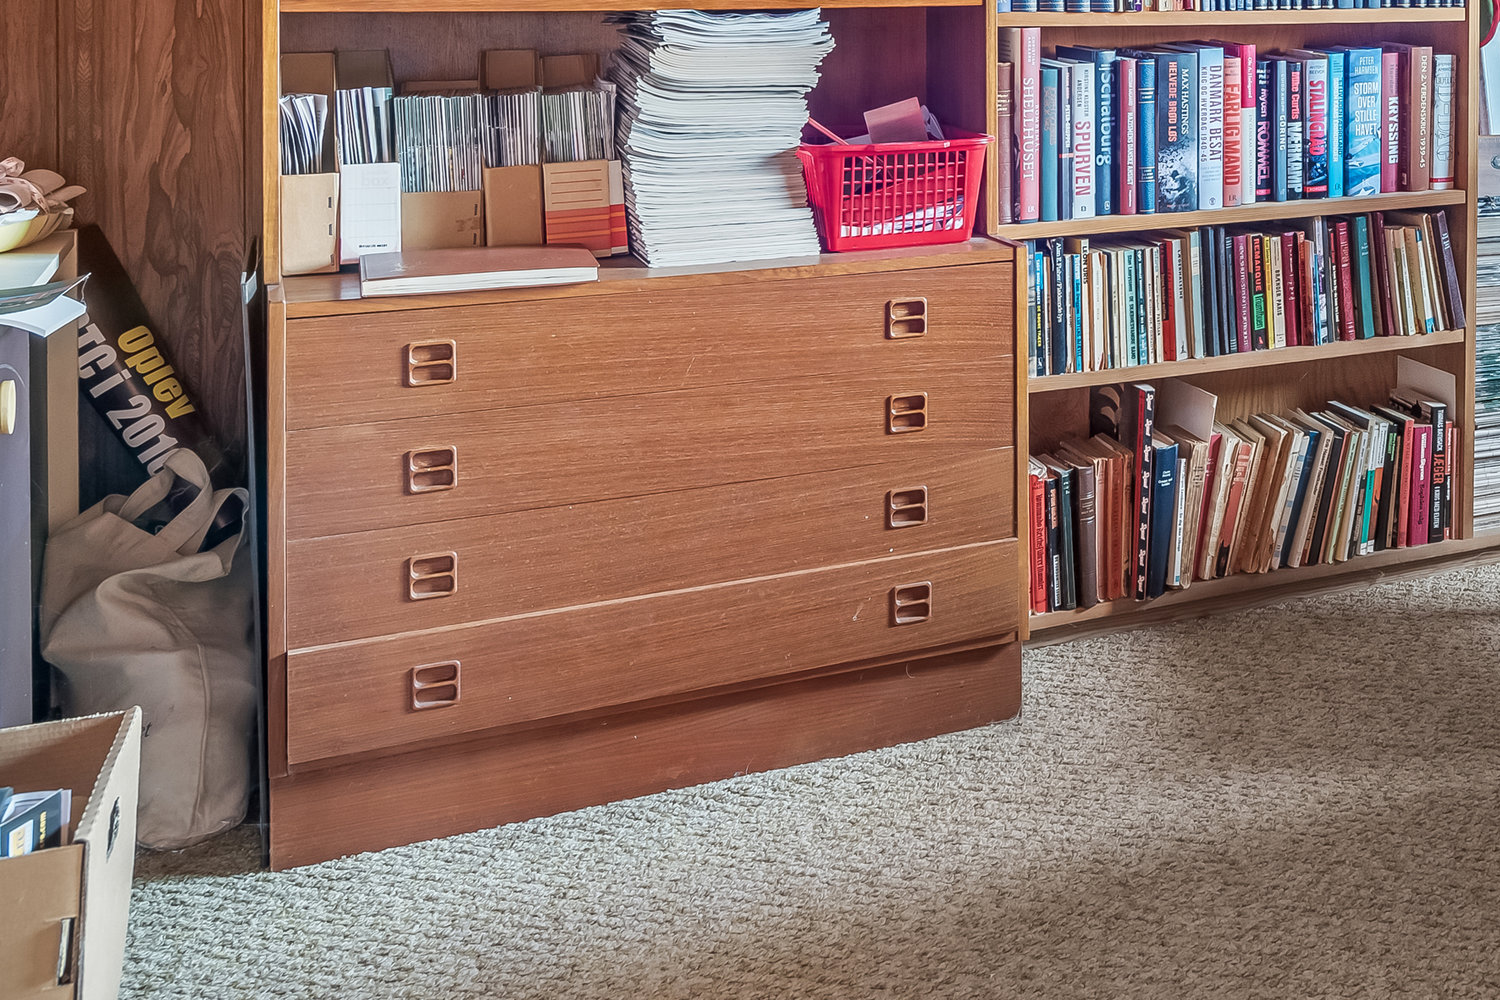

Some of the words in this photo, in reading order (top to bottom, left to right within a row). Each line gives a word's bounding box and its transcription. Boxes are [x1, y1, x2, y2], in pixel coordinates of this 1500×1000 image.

[1355, 66, 1378, 74] HARMSEN
[1360, 56, 1374, 65] PETER
[1168, 62, 1177, 98] HELVEDE
[1201, 85, 1207, 95] OG
[1209, 65, 1222, 123] DANMARK
[1354, 82, 1378, 95] STORM
[1096, 72, 1115, 166] Schalburg
[1168, 101, 1177, 124] BRØD
[1181, 91, 1189, 135] HASTINGS
[1224, 83, 1239, 137] FARLIG
[1259, 88, 1268, 117] Myten
[1292, 94, 1300, 120] Curtis
[1308, 80, 1325, 156] STALINGRAD
[1355, 109, 1378, 122] STILLE-
[1358, 95, 1376, 108] OVER
[1023, 77, 1034, 181] SHELLHUSET
[1168, 126, 1177, 142] LØS
[1209, 128, 1221, 162] BESAT
[1355, 123, 1377, 136] HAVET
[1388, 96, 1399, 164] KRYSSING
[1075, 121, 1091, 196] SPURVEN
[1224, 140, 1240, 186] MAND
[1257, 121, 1270, 185] ROMMEL
[1287, 122, 1303, 193] NÆRKAMP
[1254, 239, 1262, 291] REMARQUE
[89, 369, 132, 398] i
[118, 325, 195, 419] Oplev
[1433, 454, 1444, 484] JÆGER
